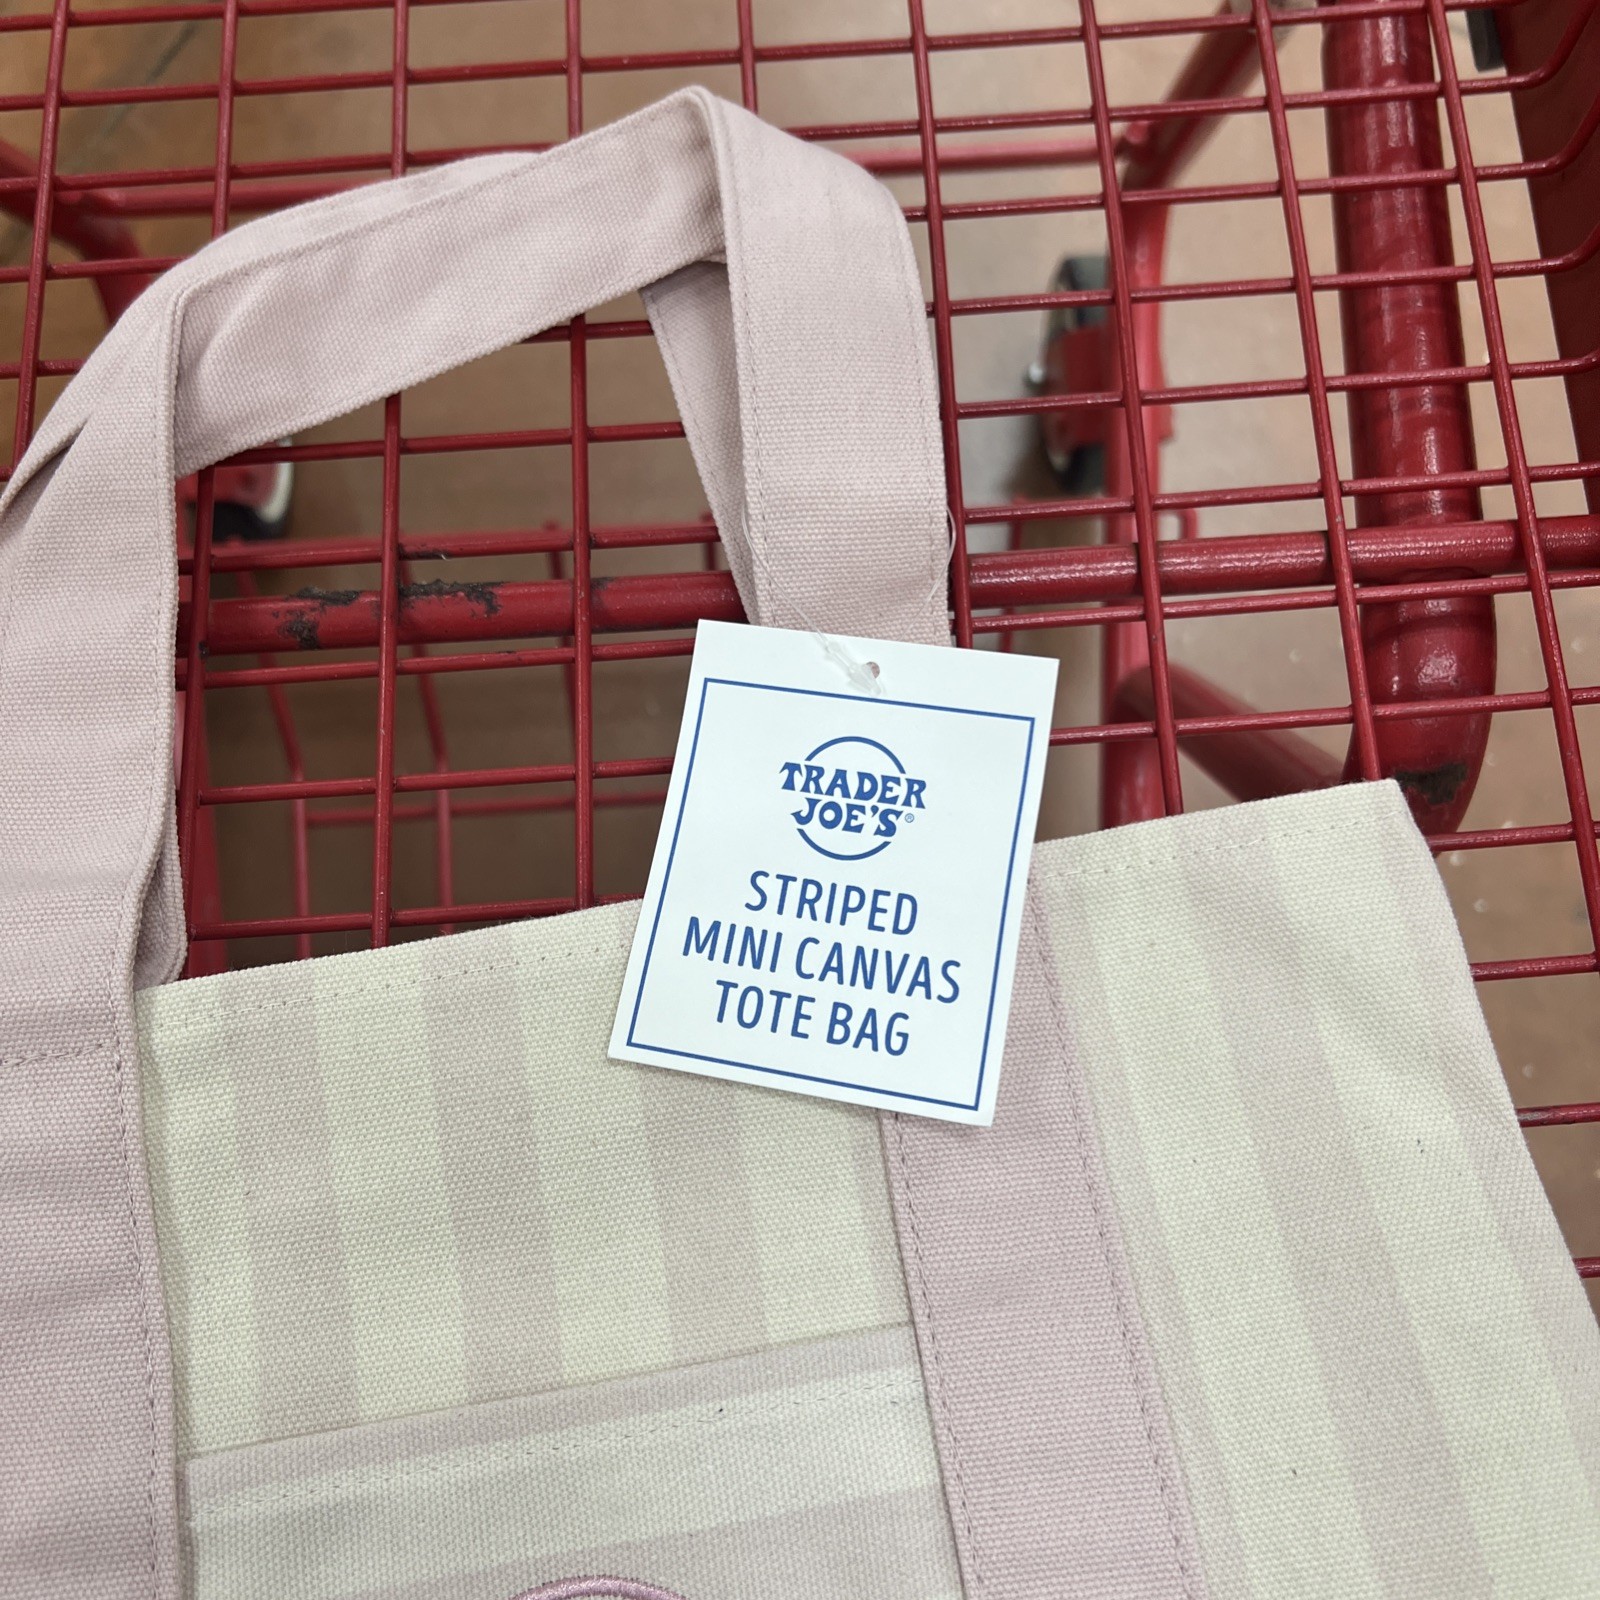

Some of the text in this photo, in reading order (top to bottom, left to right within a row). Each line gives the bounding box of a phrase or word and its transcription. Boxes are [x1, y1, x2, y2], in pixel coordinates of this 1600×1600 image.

[779, 761, 927, 809] TRADER
[745, 870, 919, 936] STRIPED
[682, 916, 960, 1004] MINI CANVAS
[716, 979, 910, 1057] TOTE BAG
